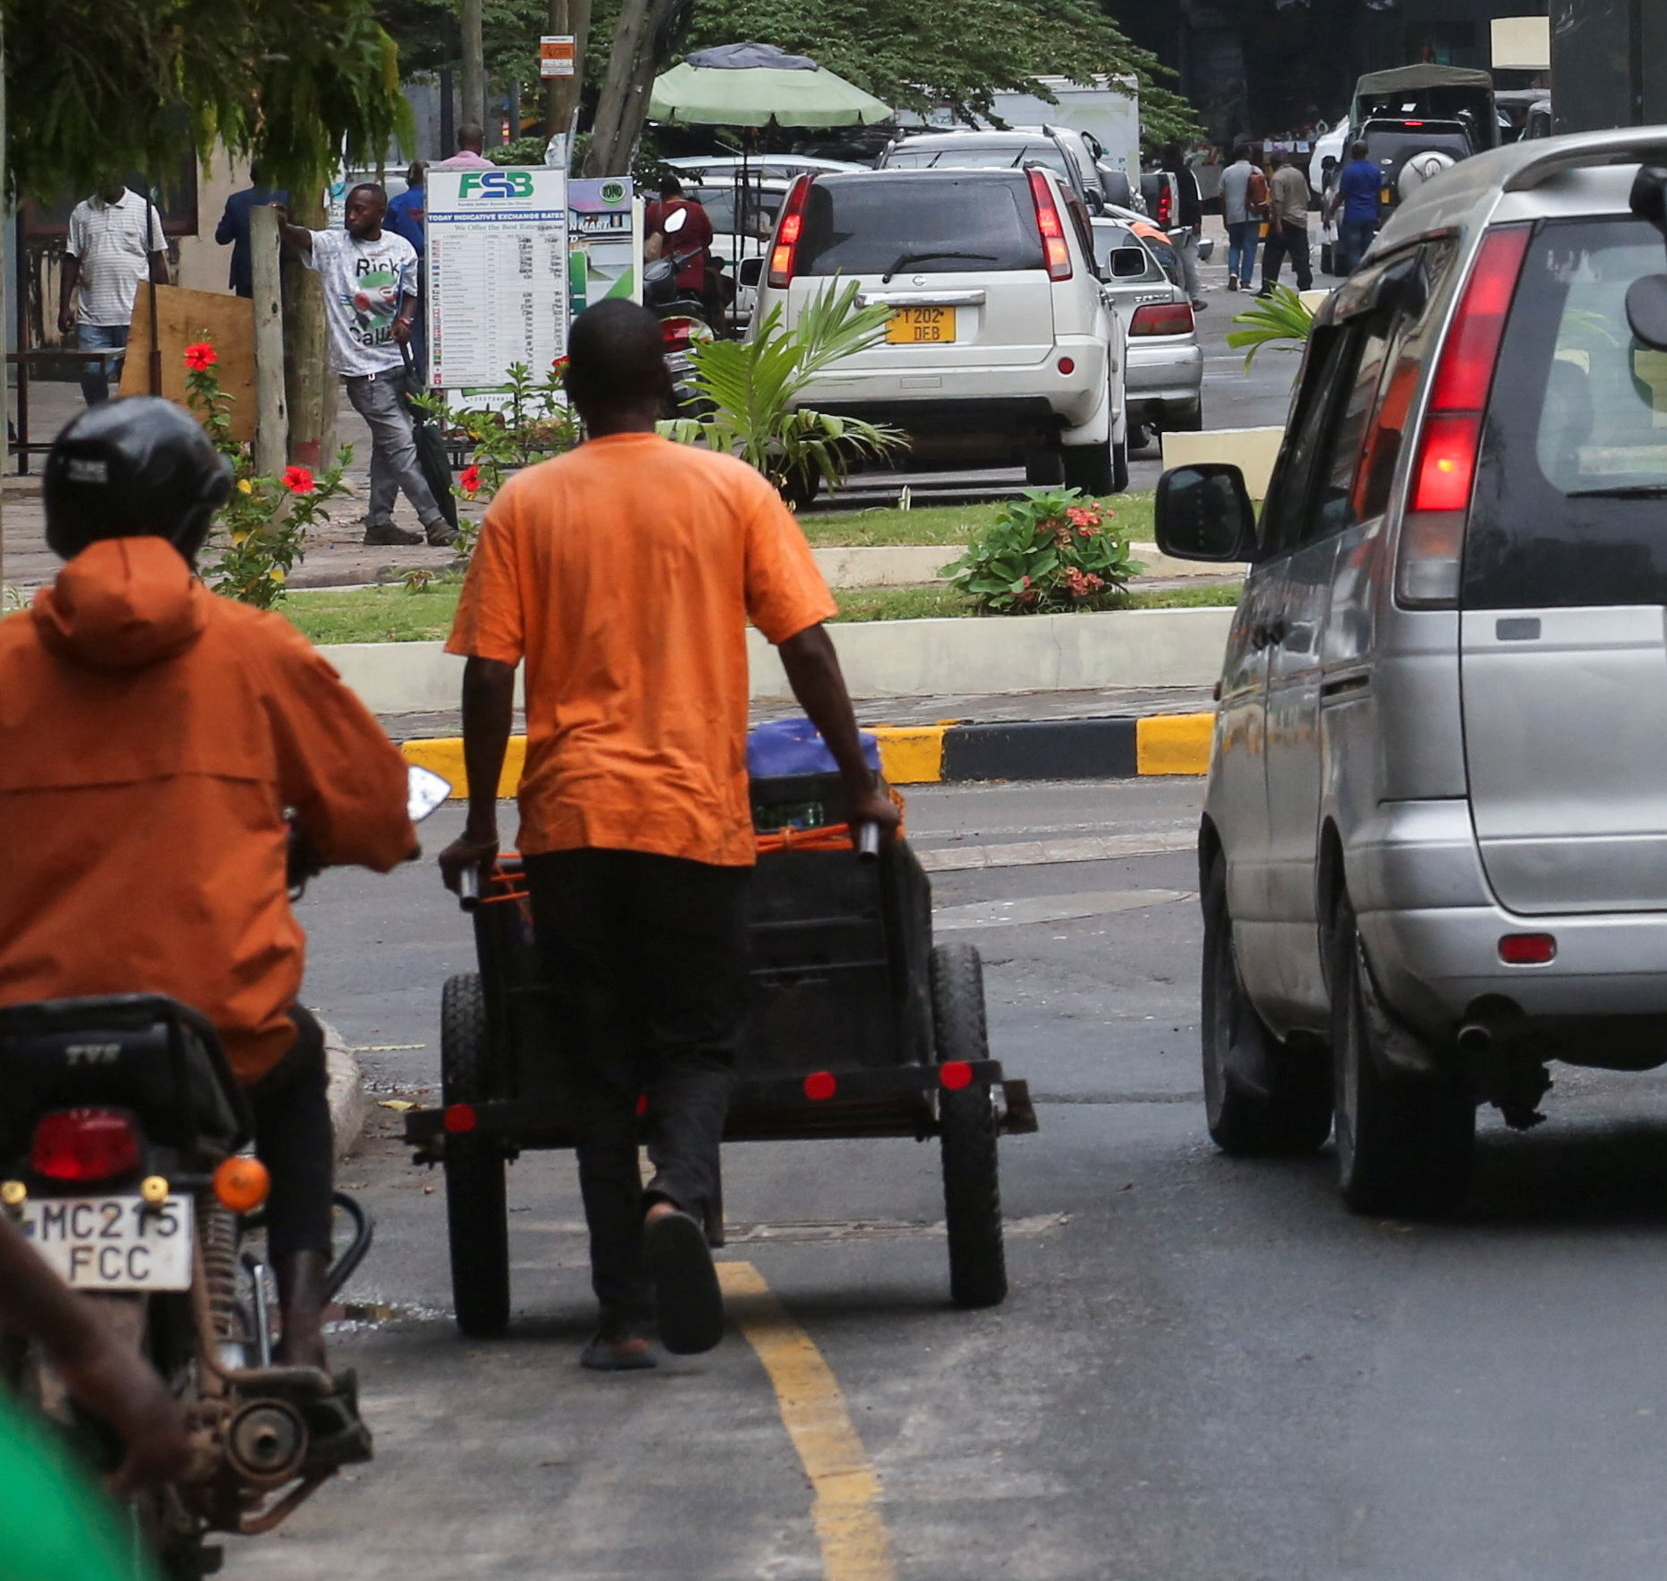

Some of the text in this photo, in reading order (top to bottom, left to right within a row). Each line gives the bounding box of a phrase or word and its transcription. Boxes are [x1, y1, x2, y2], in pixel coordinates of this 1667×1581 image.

[458, 171, 535, 199] FSB
[428, 211, 565, 222] TODAY INDICATIVE EXCHANGE RATES
[903, 307, 941, 324] T202
[69, 1245, 150, 1282] FCC
